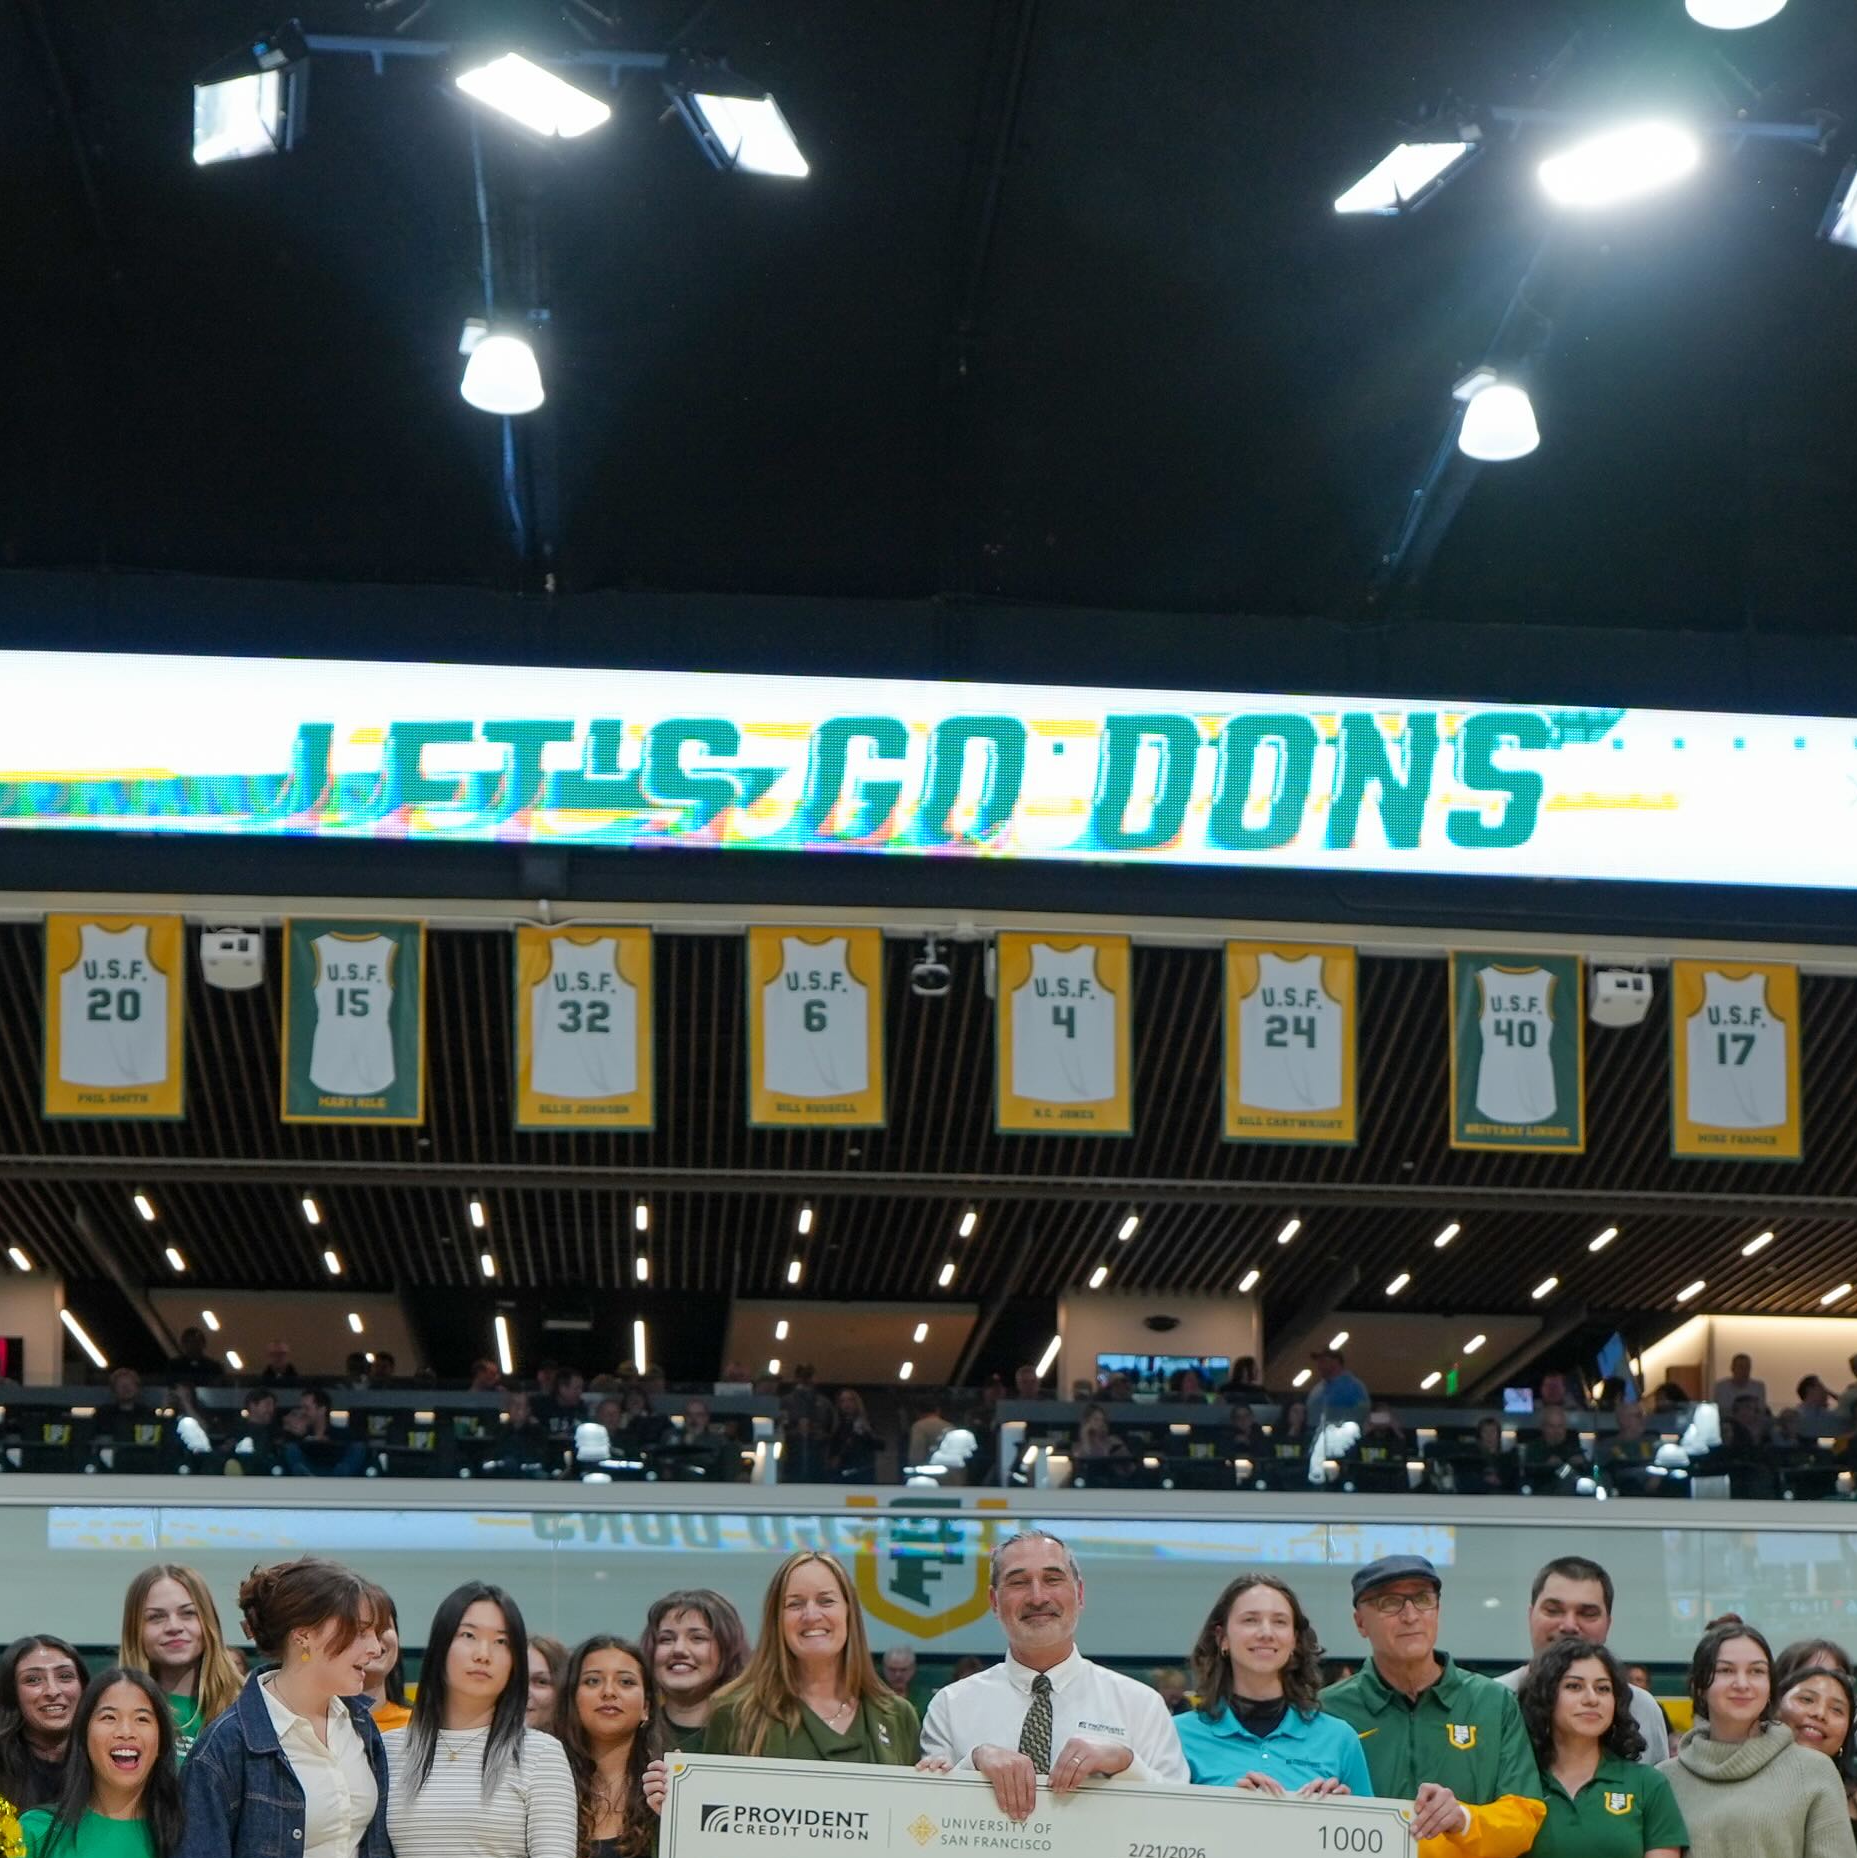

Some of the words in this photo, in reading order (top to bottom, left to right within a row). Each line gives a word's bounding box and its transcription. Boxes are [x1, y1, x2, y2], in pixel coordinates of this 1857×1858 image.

[810, 714, 1032, 848] GO
[1092, 710, 1546, 856] DONS
[83, 958, 148, 983] U.S.F.
[327, 962, 382, 984] U.S.F.
[555, 972, 617, 994] U.S.F.
[785, 972, 848, 994] U.S.F.
[1034, 978, 1096, 1000] U.S.F.
[87, 988, 141, 1022] 20
[335, 989, 370, 1018] 15
[1262, 988, 1323, 1010] U.S.F.
[1490, 996, 1543, 1016] U.S.F.
[557, 1001, 611, 1034] 32
[803, 1001, 828, 1034] 6
[1052, 1006, 1076, 1039] 4
[1708, 1005, 1767, 1029] U.S.F.
[1265, 1016, 1317, 1049] 24
[1494, 1020, 1537, 1048] 40
[1717, 1034, 1755, 1066] 17
[734, 1806, 869, 1828] PROVIDENT
[941, 1817, 1028, 1833] UNIVERSITY
[1034, 1822, 1052, 1835] OF
[733, 1824, 801, 1838] CREDIT
[809, 1827, 869, 1841] UNION
[941, 1834, 968, 1846] SAN
[973, 1835, 1052, 1850] FRANCISCO
[1318, 1825, 1383, 1853] 1000
